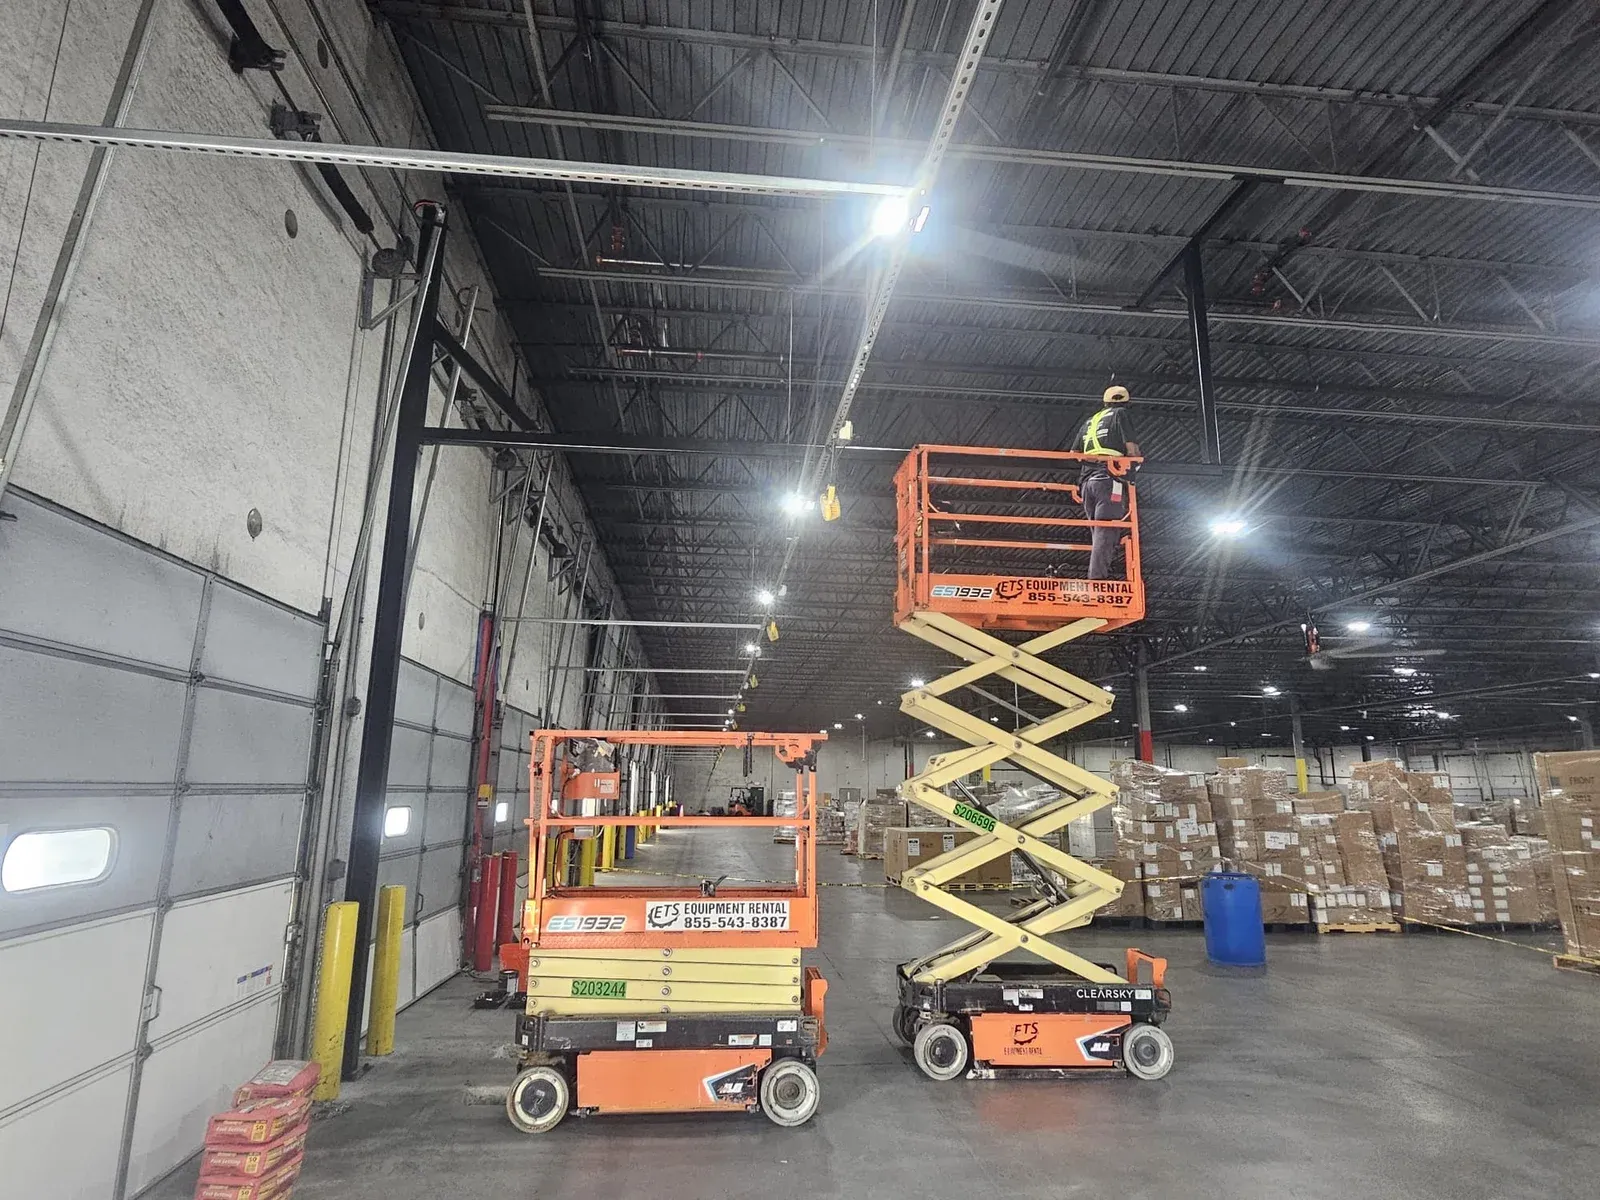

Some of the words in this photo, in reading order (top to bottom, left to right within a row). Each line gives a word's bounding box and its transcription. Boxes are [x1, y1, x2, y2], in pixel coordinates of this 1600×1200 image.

[932, 586, 993, 598] ES1932
[1000, 579, 1024, 593] ETS
[1026, 580, 1090, 593] EQUIPMENT
[1092, 582, 1134, 594] RENTAL
[1028, 593, 1133, 605] 855-543-8387
[952, 803, 996, 833] S206596
[653, 902, 680, 919] ETS
[684, 902, 747, 915] EQUIPMENT
[748, 902, 787, 914] RENTAL
[548, 916, 626, 930] ES1932
[684, 916, 787, 929] 855-543-8387
[571, 980, 626, 997] S203244
[1076, 989, 1134, 999] CLEARSKY
